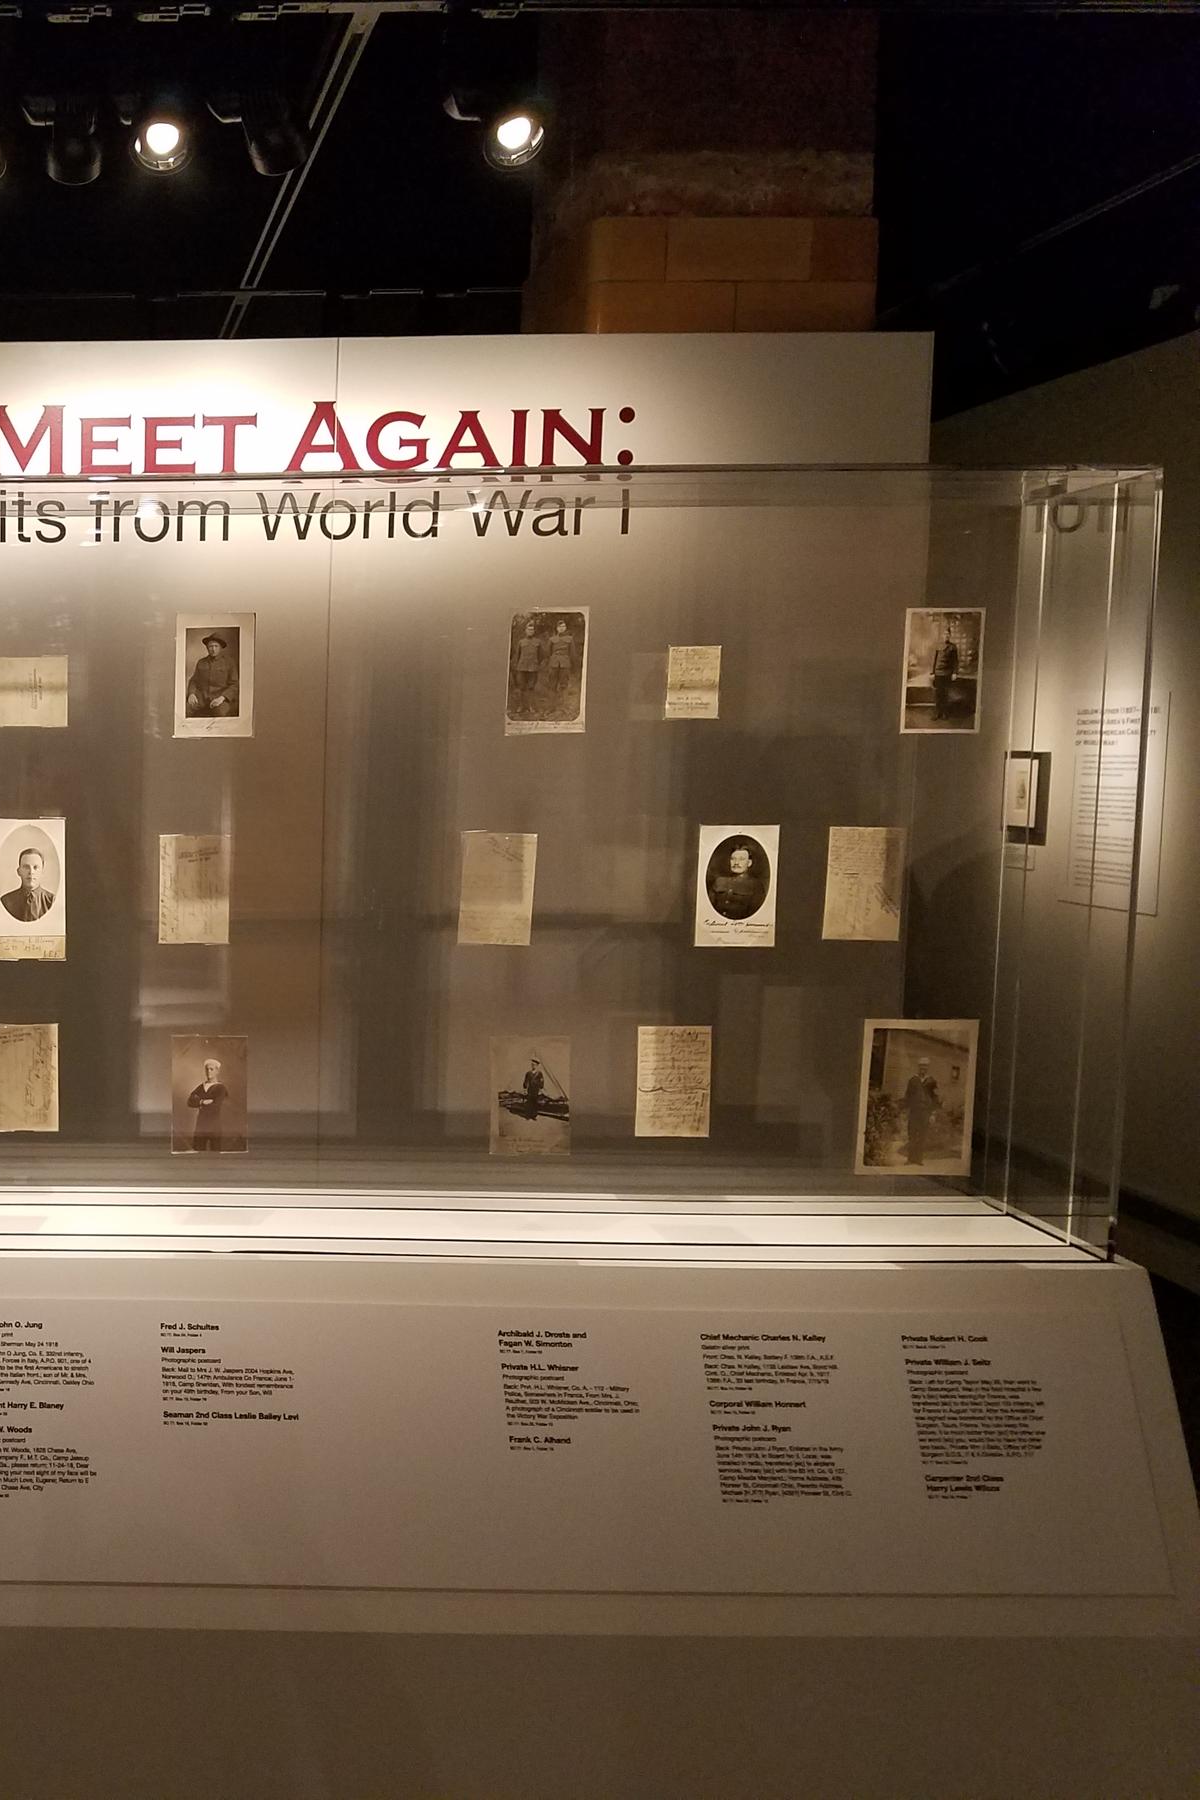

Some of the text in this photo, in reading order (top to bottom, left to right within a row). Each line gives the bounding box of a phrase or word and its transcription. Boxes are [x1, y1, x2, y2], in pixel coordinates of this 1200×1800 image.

[282, 400, 636, 473] AGAIN:
[94, 490, 229, 543] from
[256, 490, 440, 540] World
[466, 488, 595, 537] War
[620, 488, 631, 535] I
[25, 1321, 43, 1330] Jung
[497, 1329, 534, 1338] Archibald
[722, 1334, 760, 1342] Mechanic
[761, 1334, 790, 1342] Charles
[498, 1339, 522, 1348] Fagan
[535, 1340, 573, 1348] Simonton
[176, 1346, 206, 1355] Jaspers
[501, 1363, 528, 1371] Private
[7, 1402, 28, 1411] Harry
[39, 1402, 64, 1411] Blaney
[709, 1400, 743, 1409] Corporal
[744, 1400, 774, 1408] William
[163, 1411, 194, 1419] Seaman
[195, 1411, 210, 1419] 2nd
[234, 1412, 257, 1420] Leslie
[258, 1413, 282, 1421] Bailey
[712, 1424, 740, 1432] Private
[771, 1425, 792, 1433] Ryan
[924, 1475, 965, 1483] Carpenter
[926, 1485, 948, 1493] Harry
